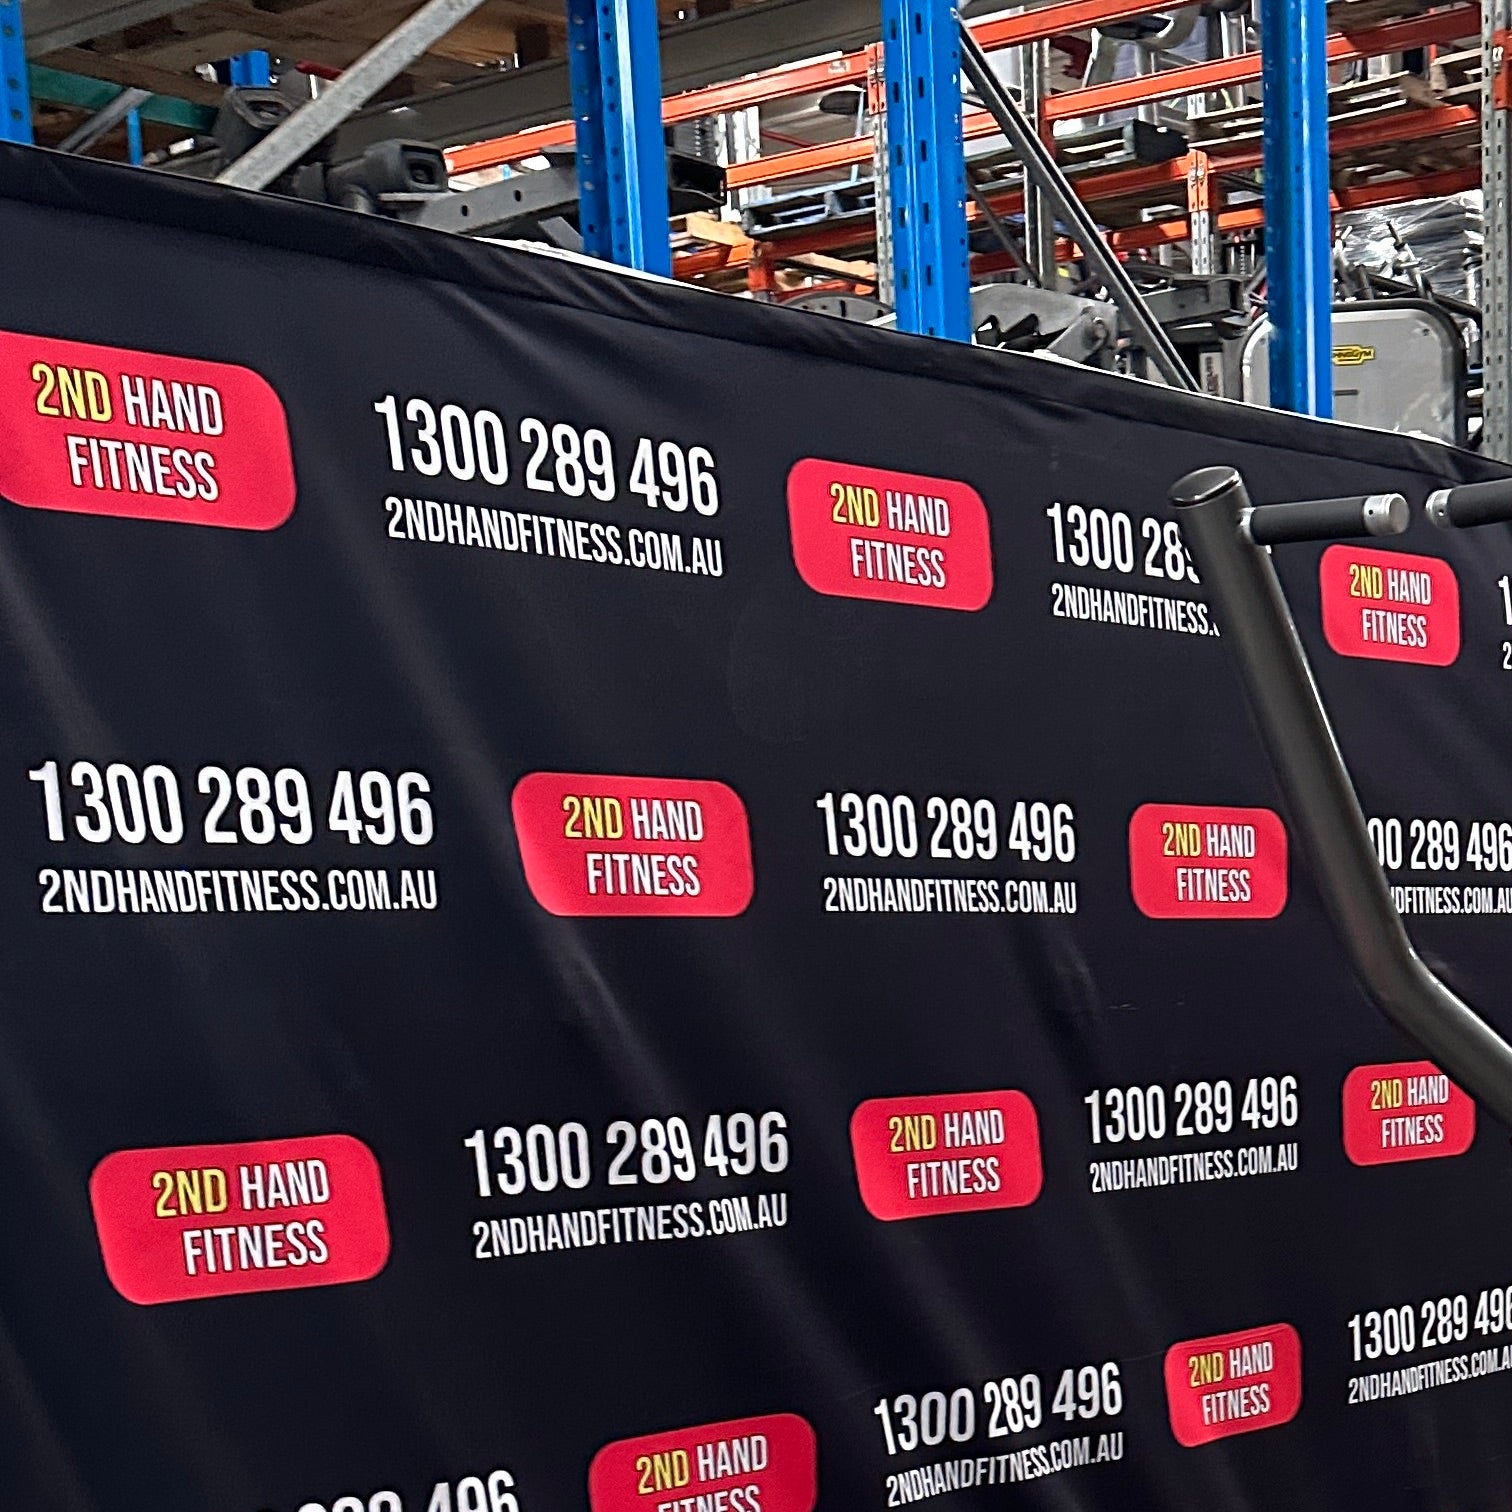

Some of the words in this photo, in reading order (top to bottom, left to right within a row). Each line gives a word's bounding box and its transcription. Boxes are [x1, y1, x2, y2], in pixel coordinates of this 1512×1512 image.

[30, 362, 113, 423] 2ND
[120, 375, 224, 436] HAND
[66, 436, 219, 502] FITNESS
[374, 395, 510, 486] 1300
[520, 417, 617, 501] 289
[628, 437, 720, 517] 496
[384, 497, 724, 577] 2NDHANDFITNESS.COM.AU
[830, 483, 880, 528] 2ND
[885, 492, 950, 538] HAND
[1047, 502, 1134, 573] 1300
[850, 538, 946, 589] FITNESS
[1349, 563, 1384, 601] 2ND
[1386, 570, 1432, 606] HAND
[1051, 582, 1221, 637] 2NDHANDFITNESS.
[1361, 609, 1427, 649] FITNESS
[28, 760, 184, 844] 1300
[198, 766, 313, 845] 289
[329, 770, 434, 846] 496
[562, 795, 624, 840] 2ND
[630, 799, 705, 842] HAND
[816, 791, 918, 859] 1300
[929, 796, 998, 861] 289
[1008, 801, 1076, 863] 496
[1162, 823, 1201, 858] 2ND
[1206, 824, 1256, 859] HAND
[1367, 817, 1403, 870] 00
[1409, 819, 1460, 871] 289
[38, 869, 438, 914] 2NDHANDFITNESS.COM.AU
[586, 853, 700, 896] FITNESS
[823, 876, 1077, 915] 2NDHANDFITNESS.COM.AU
[1176, 866, 1251, 902] FITNESS
[1084, 1084, 1166, 1145] 1300
[1174, 1079, 1233, 1137] 289
[1241, 1075, 1298, 1130] 496
[1370, 1078, 1403, 1111] 2ND
[1406, 1074, 1450, 1106] HAND
[463, 1121, 590, 1199] 1300
[606, 1115, 697, 1187] 289
[702, 1110, 789, 1178] 496
[888, 1114, 938, 1153] 2ND
[943, 1108, 1005, 1149] HAND
[1380, 1114, 1444, 1149] FITNESS
[151, 1167, 228, 1219] 2ND
[238, 1158, 331, 1212] HAND
[906, 1157, 1001, 1199] FITNESS
[1089, 1142, 1298, 1194] 2NDHANDFITNESS.COM.AU
[182, 1219, 329, 1277] FITNESS
[473, 1192, 789, 1260] 2NDHANDFITNESS.COM.AU
[1348, 1303, 1415, 1362] 1300
[1420, 1294, 1468, 1349] 289
[1188, 1351, 1225, 1389] 2ND
[1229, 1341, 1273, 1380] HAND
[873, 1387, 975, 1457] 1300
[984, 1373, 1042, 1438] 289
[1051, 1362, 1123, 1422] 496
[1201, 1384, 1270, 1426] FITNESS
[635, 1448, 690, 1495] 2ND
[695, 1434, 769, 1483] HAND
[886, 1432, 1124, 1509] 2NDHANDFITNESS.COM.AU
